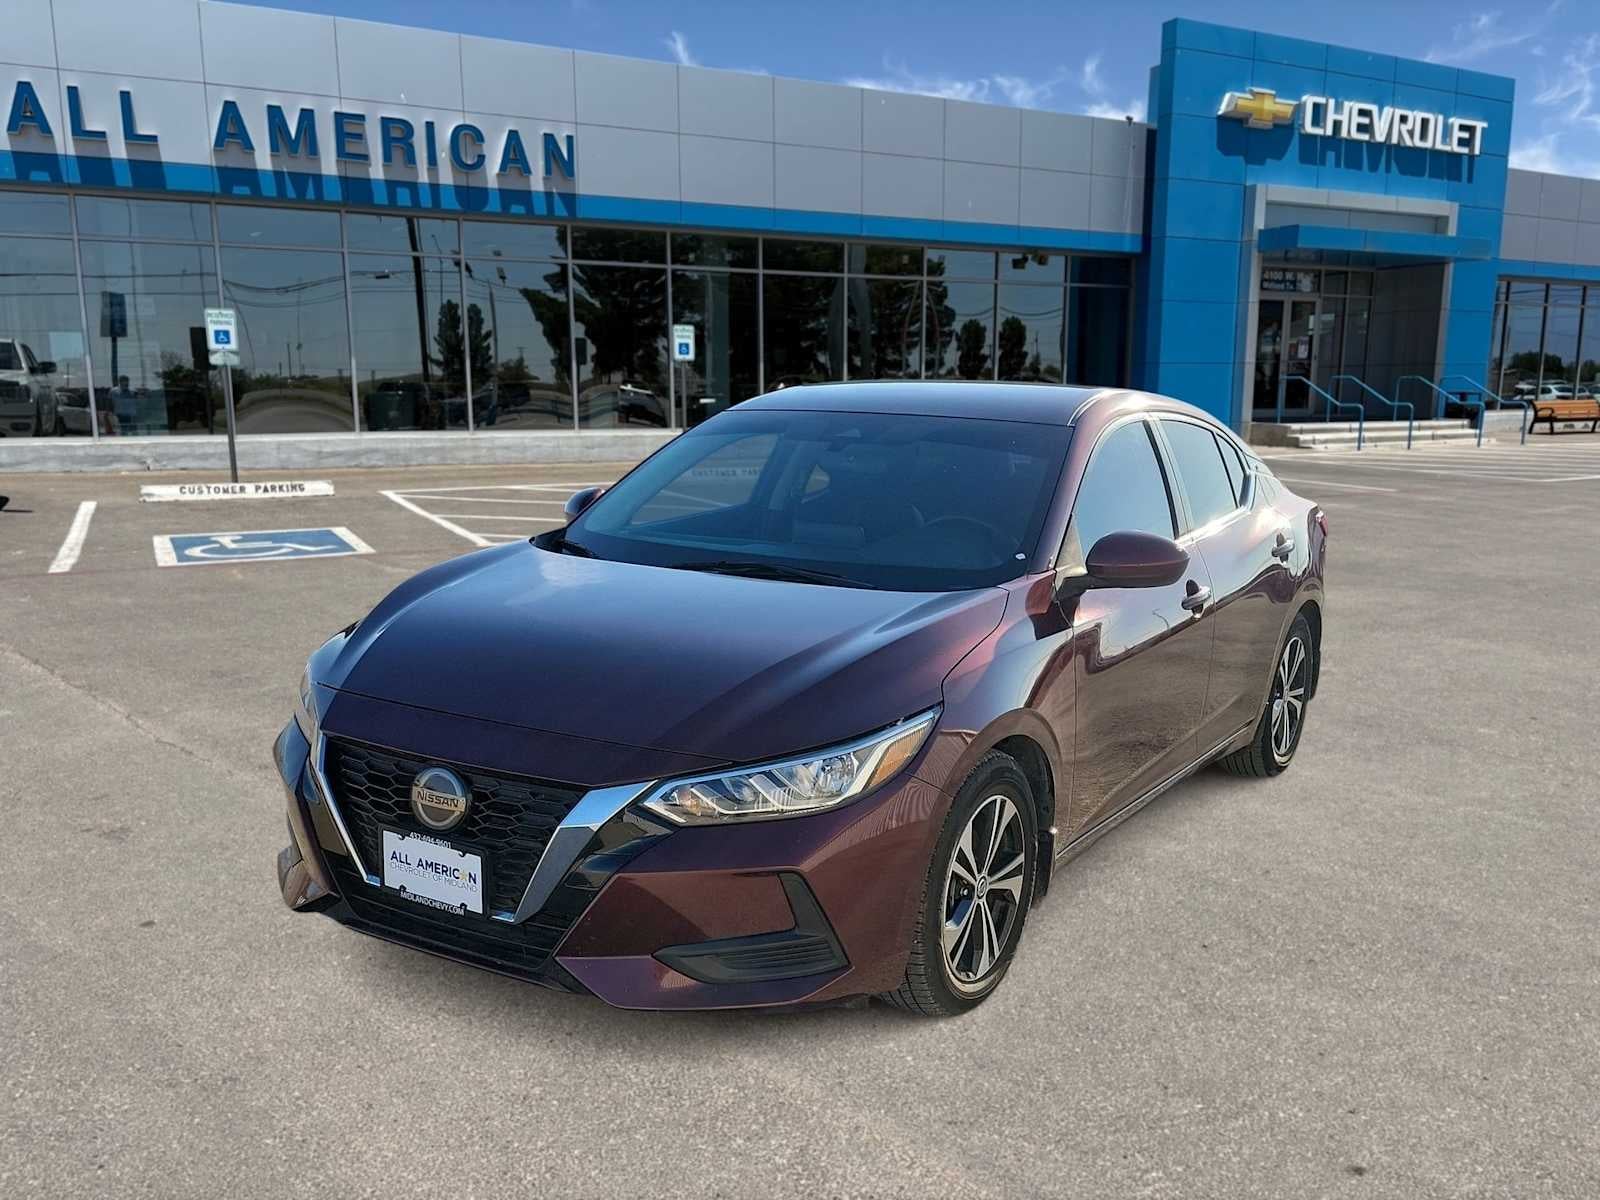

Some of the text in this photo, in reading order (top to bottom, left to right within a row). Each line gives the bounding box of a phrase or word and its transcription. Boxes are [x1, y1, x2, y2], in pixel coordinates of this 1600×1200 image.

[7, 81, 576, 179] ALL AMERICAN
[1300, 94, 1488, 156] CHEVROLET
[179, 483, 306, 495] CUSTOMER PARKING
[416, 790, 459, 808] NISSAN
[390, 850, 412, 866] ALL
[390, 862, 430, 878] CHEVROLET
[432, 874, 442, 882] OF
[399, 890, 465, 916] MIDLANDCHEVY.COM
